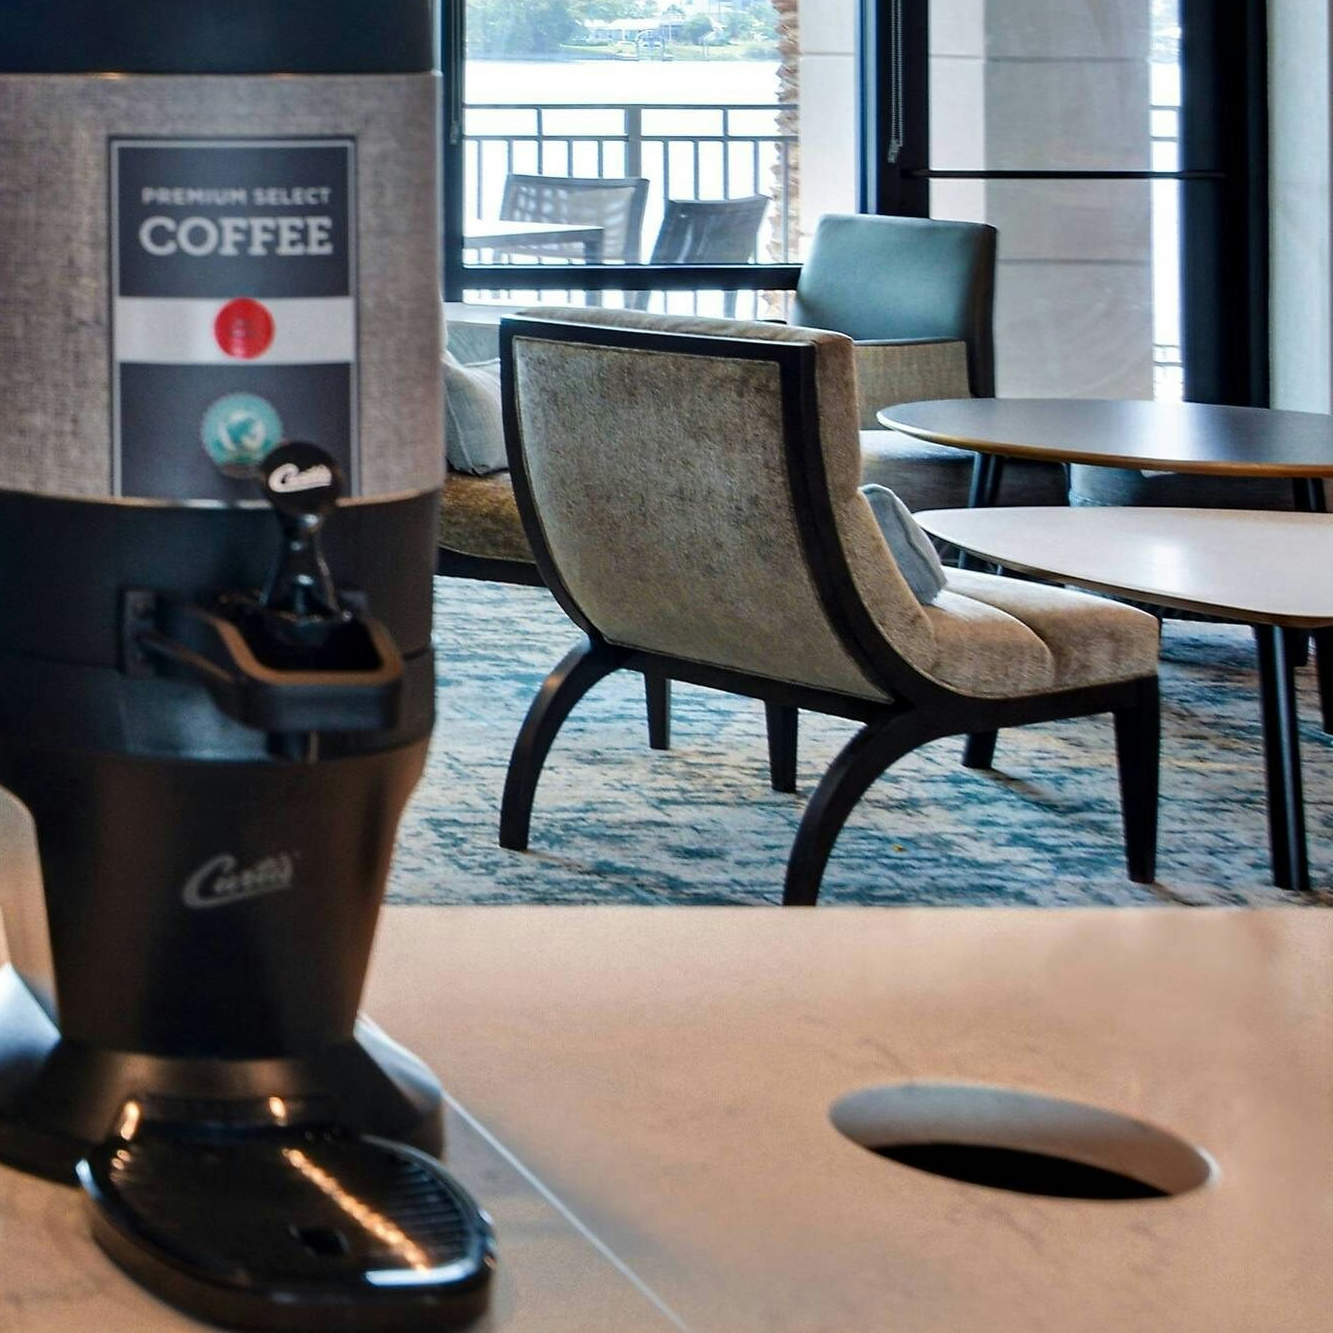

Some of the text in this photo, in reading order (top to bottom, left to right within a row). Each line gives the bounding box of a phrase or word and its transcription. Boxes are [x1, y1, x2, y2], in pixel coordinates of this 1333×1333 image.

[141, 187, 333, 206] PREMIUM SELECT
[138, 216, 333, 257] COFFEE
